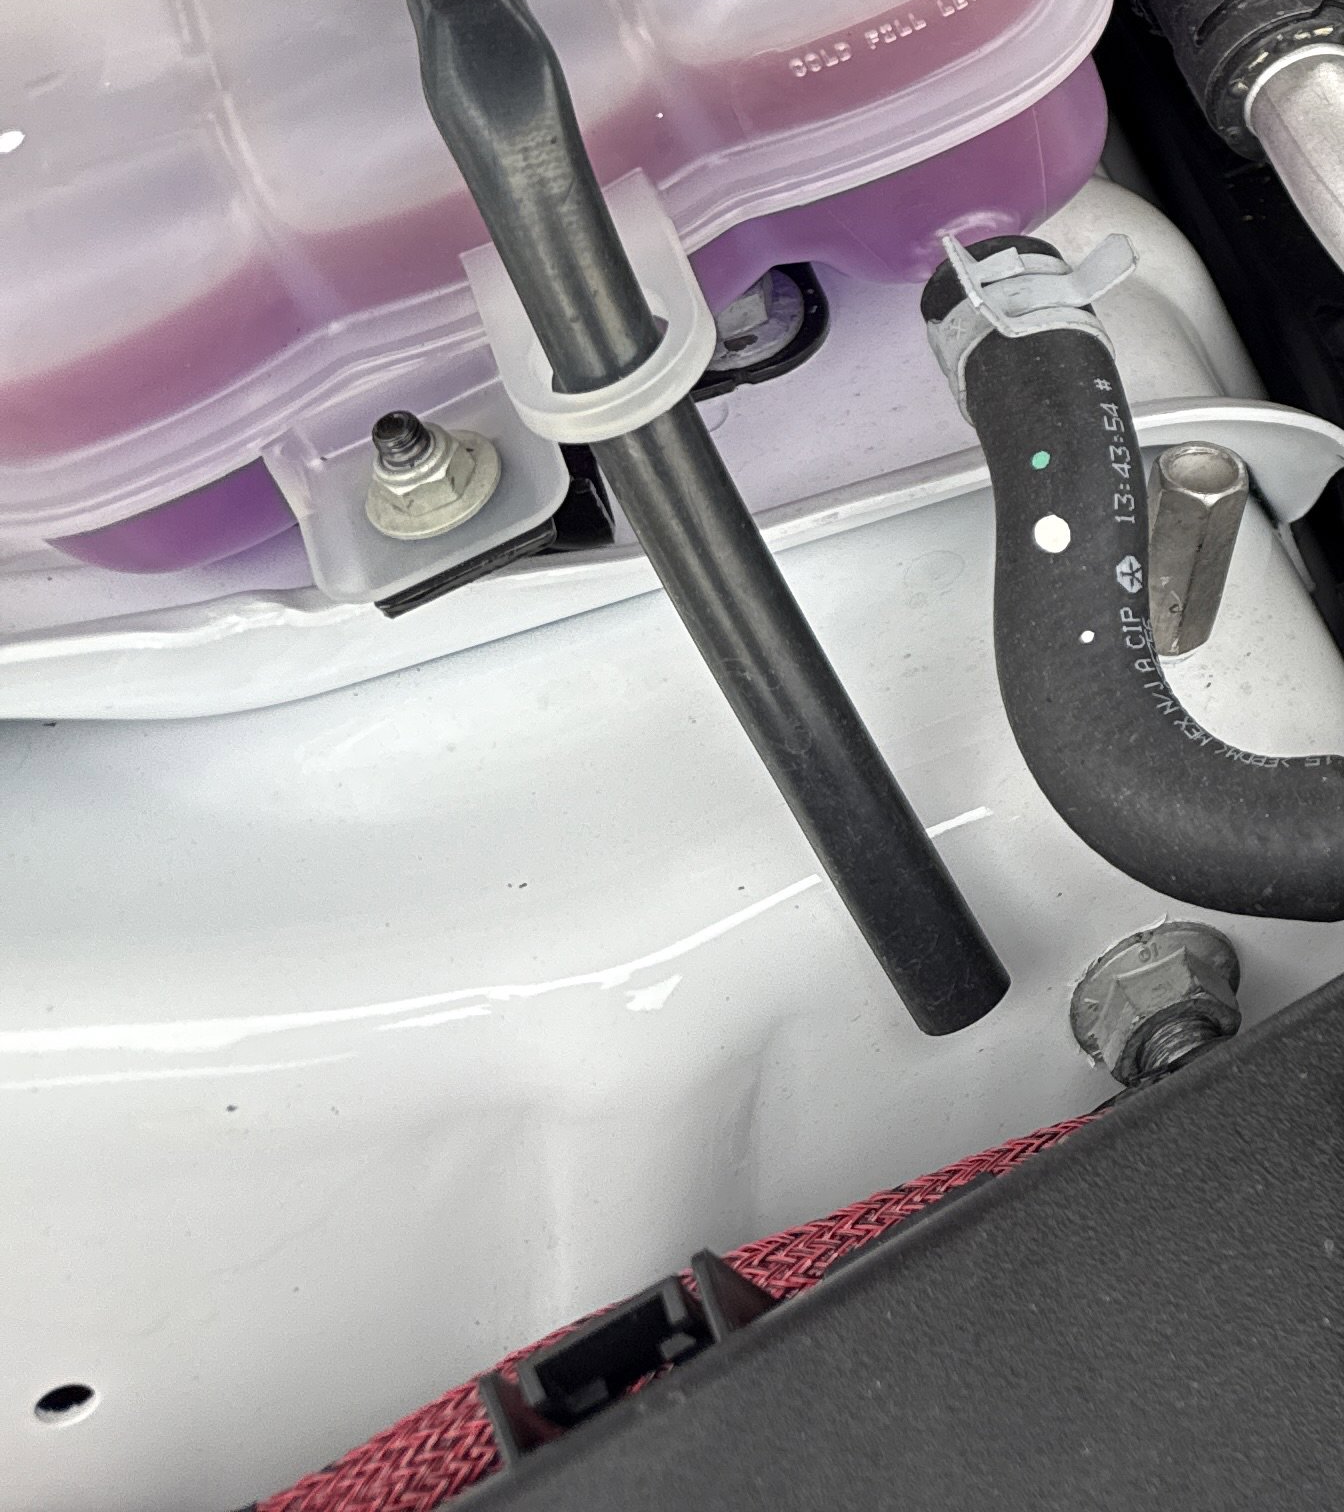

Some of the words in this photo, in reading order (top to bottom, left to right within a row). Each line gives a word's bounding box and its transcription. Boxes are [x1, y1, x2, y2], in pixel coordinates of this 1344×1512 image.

[789, 41, 851, 78] COLD
[864, 13, 927, 50] FILL
[1100, 402, 1136, 524] 13:43:54
[1119, 606, 1146, 649] CIP
